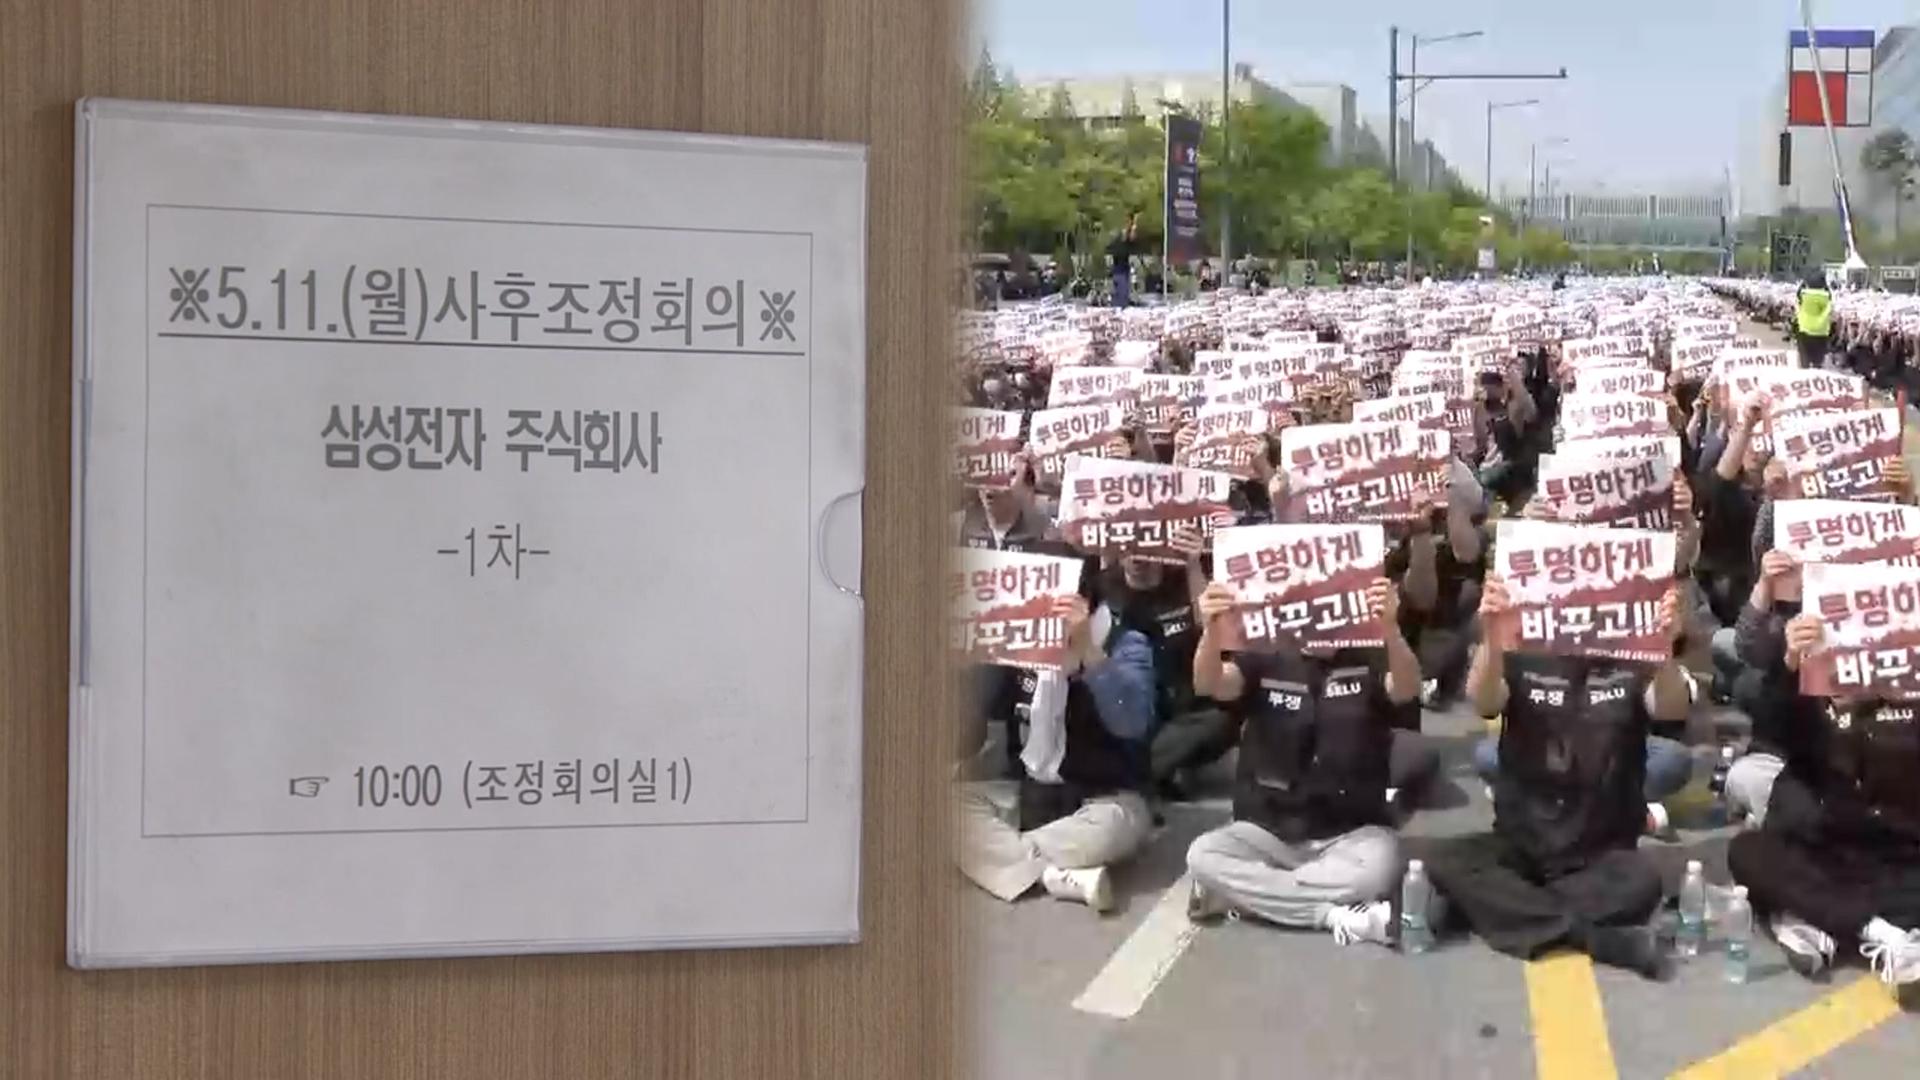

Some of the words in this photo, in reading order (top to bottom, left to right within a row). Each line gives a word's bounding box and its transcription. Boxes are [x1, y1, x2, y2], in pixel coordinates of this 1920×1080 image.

[320, 403, 487, 472] 삼성전자
[505, 409, 663, 474] 주식회사
[1291, 424, 1402, 476] 투명하게
[1785, 412, 1887, 463] 투명하게
[1073, 471, 1184, 507] 투명하게
[1546, 460, 1657, 508] 투명하게
[1787, 508, 1906, 550] 투명하게
[1225, 530, 1364, 590] 투명하게
[1507, 537, 1654, 588] 투명하게
[353, 763, 443, 807] 10:00
[462, 756, 694, 809] (조정회의실1)
